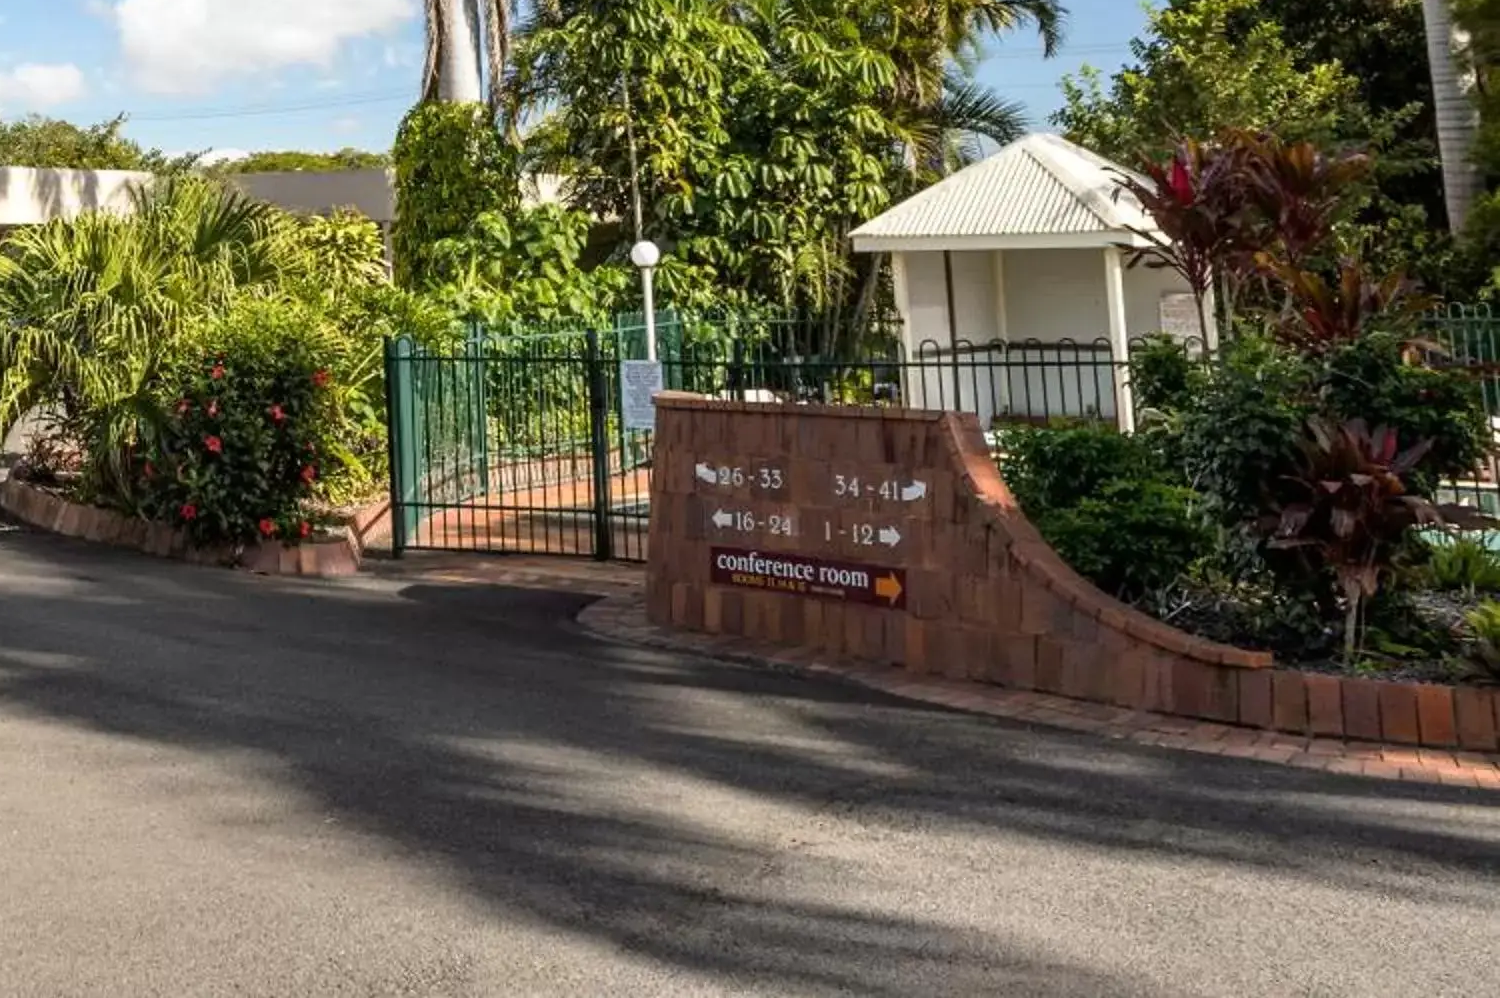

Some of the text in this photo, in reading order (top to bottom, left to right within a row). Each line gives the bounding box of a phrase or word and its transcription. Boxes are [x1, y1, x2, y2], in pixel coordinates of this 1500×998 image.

[835, 474, 859, 497] 34
[879, 481, 899, 501] 41
[852, 523, 873, 545] 12
[717, 551, 815, 581] conference
[819, 566, 869, 590] room
